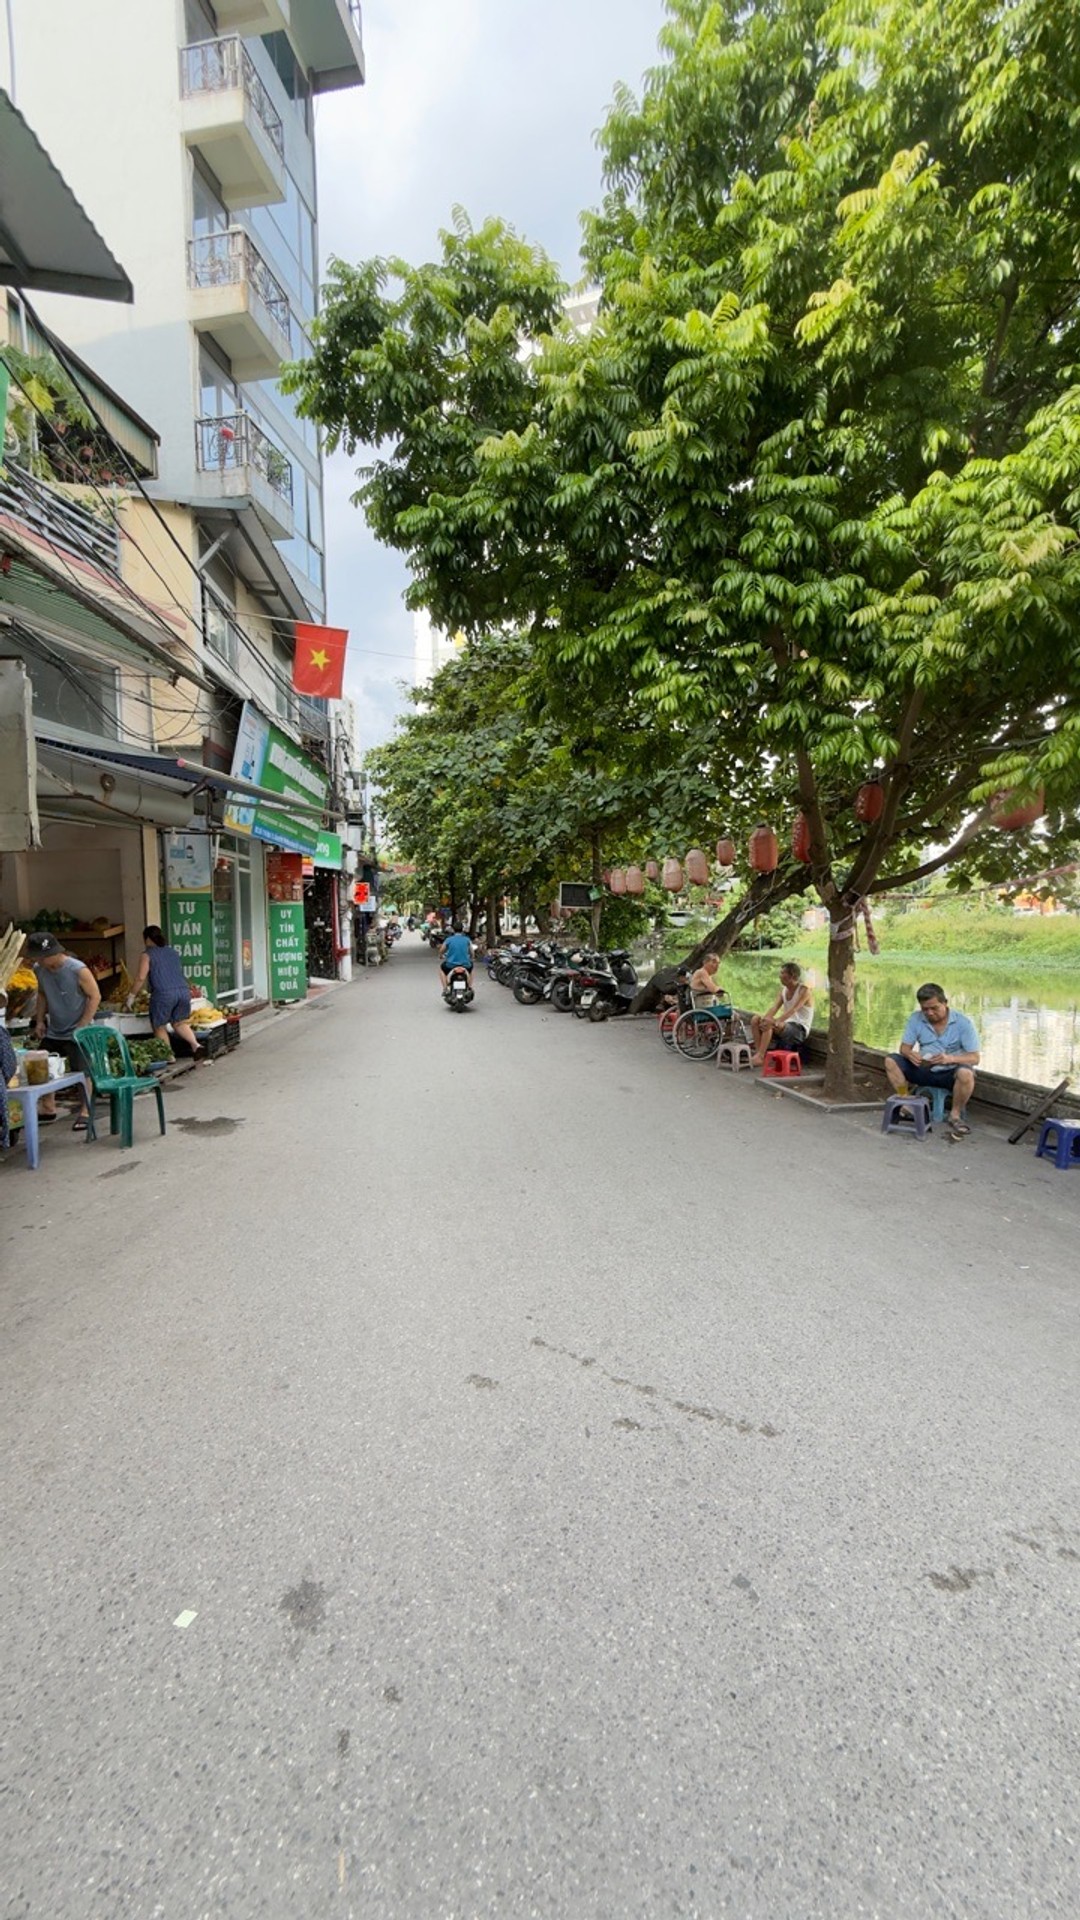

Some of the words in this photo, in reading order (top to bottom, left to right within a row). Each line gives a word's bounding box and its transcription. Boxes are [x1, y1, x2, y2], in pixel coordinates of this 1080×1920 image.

[280, 909, 292, 919] UY
[173, 918, 202, 936] VẤN
[279, 923, 295, 933] TÍN
[276, 935, 299, 948] CHẤT
[273, 952, 303, 963] LƯỢNG
[182, 960, 211, 978] UỐC
[277, 965, 299, 978] HIỆU
